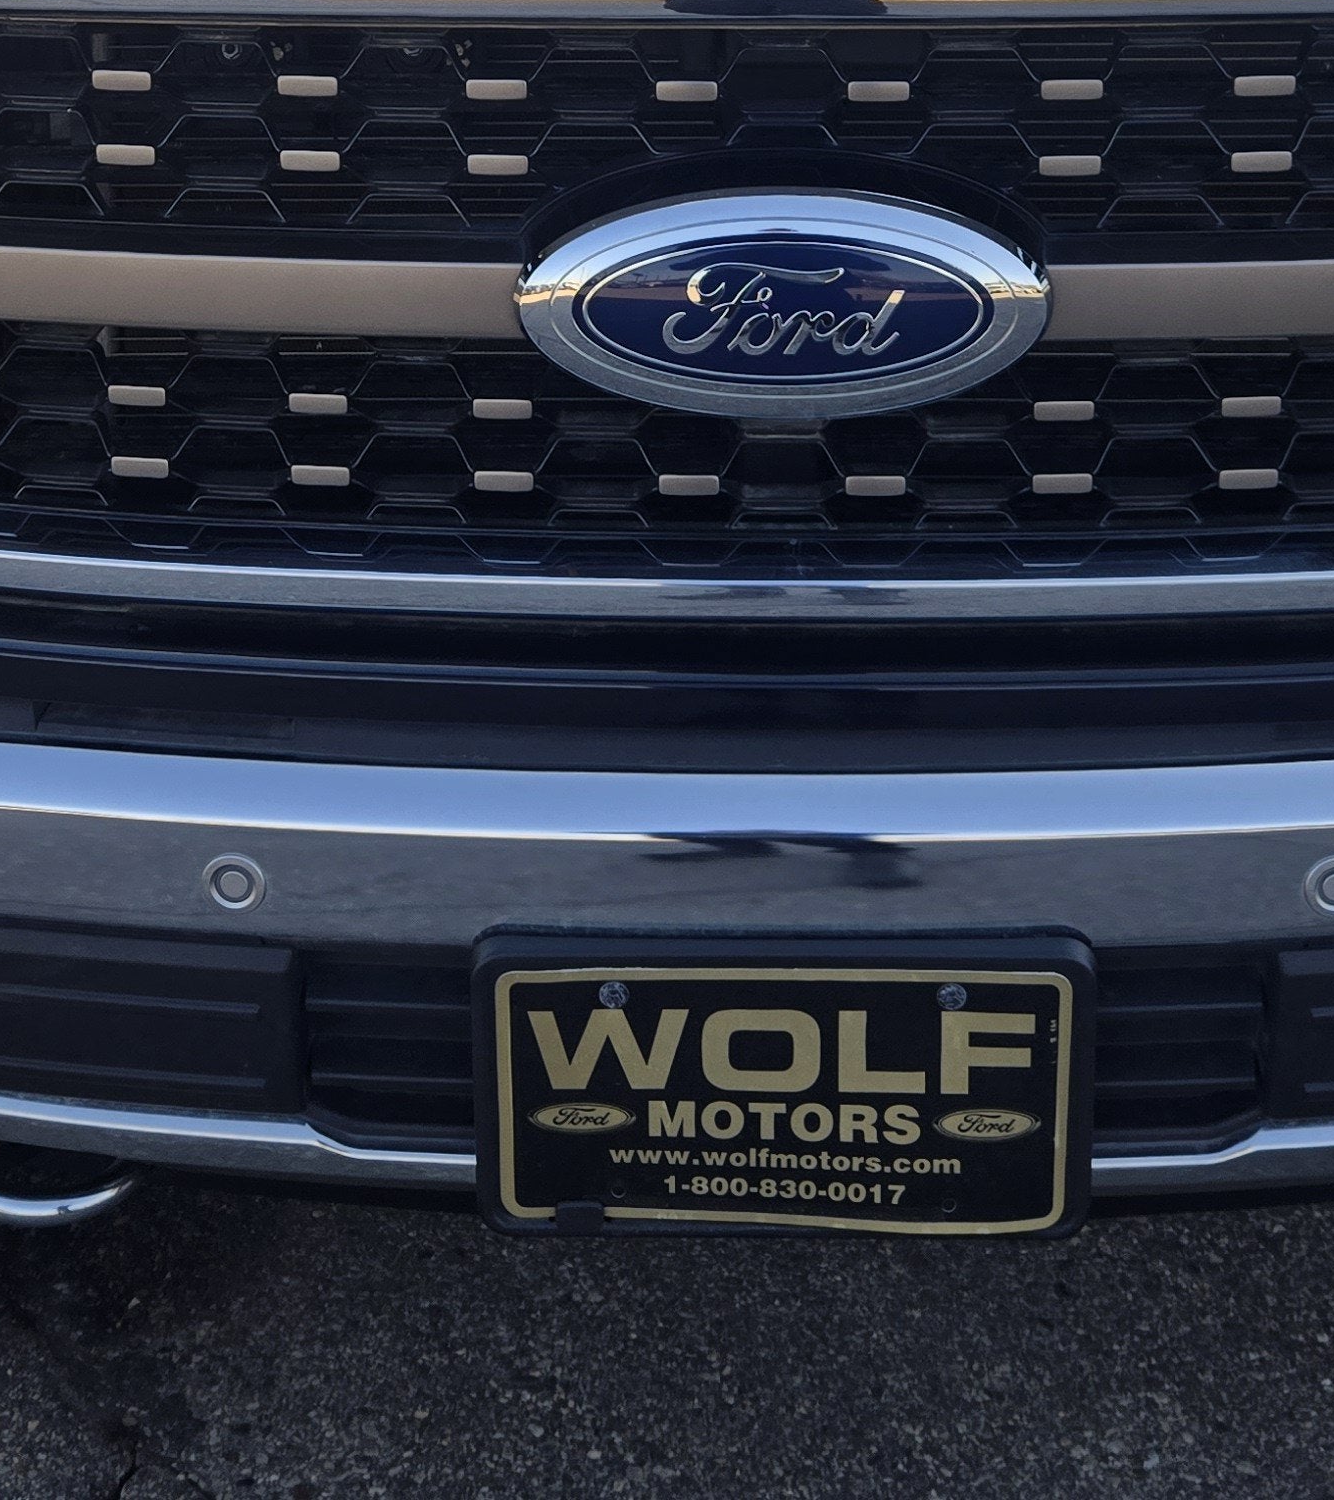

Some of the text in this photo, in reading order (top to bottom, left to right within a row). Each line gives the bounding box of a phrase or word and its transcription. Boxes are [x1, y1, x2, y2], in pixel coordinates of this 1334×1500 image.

[662, 261, 906, 356] Ford
[526, 1008, 1037, 1095] WOLF
[552, 1107, 610, 1127] Ford
[647, 1100, 922, 1146] MOTORS
[957, 1113, 1016, 1134] Ford
[609, 1147, 962, 1175] www.wolfmotors.com
[664, 1175, 907, 1206] 1-800-830-0017
